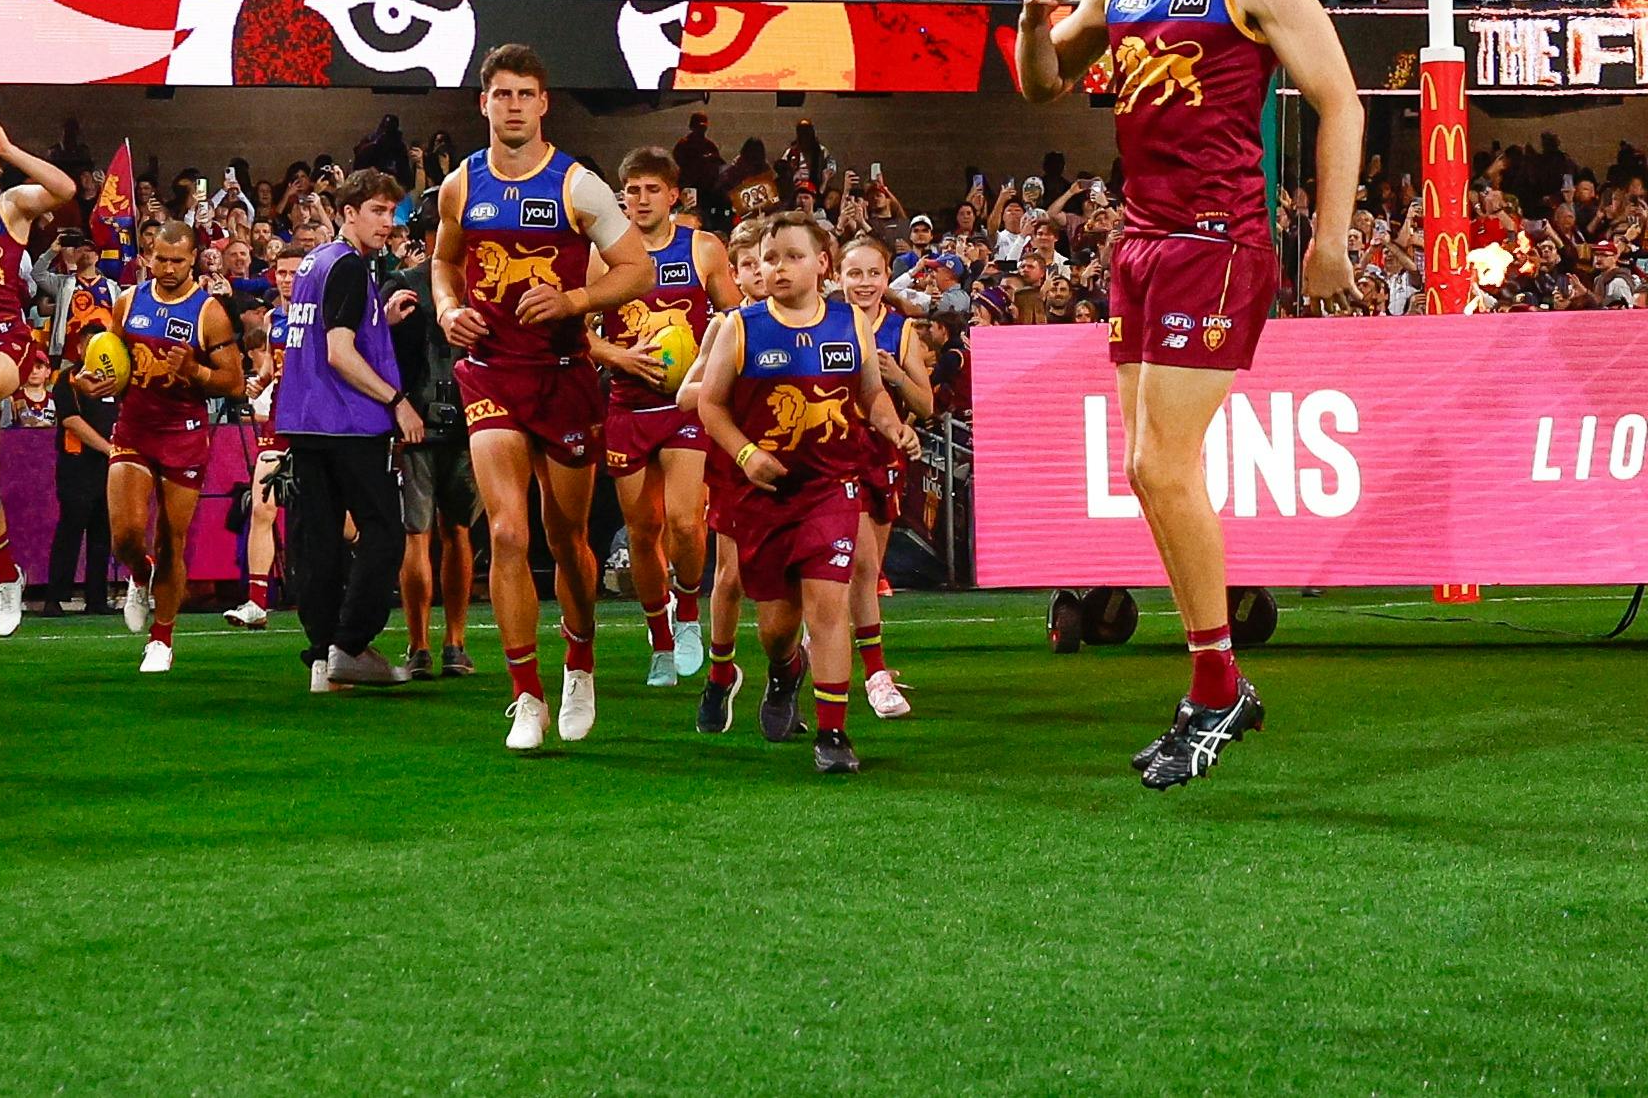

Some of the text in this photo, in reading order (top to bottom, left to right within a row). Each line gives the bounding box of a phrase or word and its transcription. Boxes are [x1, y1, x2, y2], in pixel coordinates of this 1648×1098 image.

[1468, 16, 1648, 85] THE F
[469, 205, 496, 218] AFL
[525, 204, 553, 222] youi
[663, 265, 687, 282] youi
[169, 323, 190, 338] youi
[1164, 316, 1192, 329] AFL
[1202, 316, 1232, 329] LIONS
[758, 353, 788, 365] AFL
[825, 347, 852, 367] youi
[1084, 388, 1362, 519] LNS
